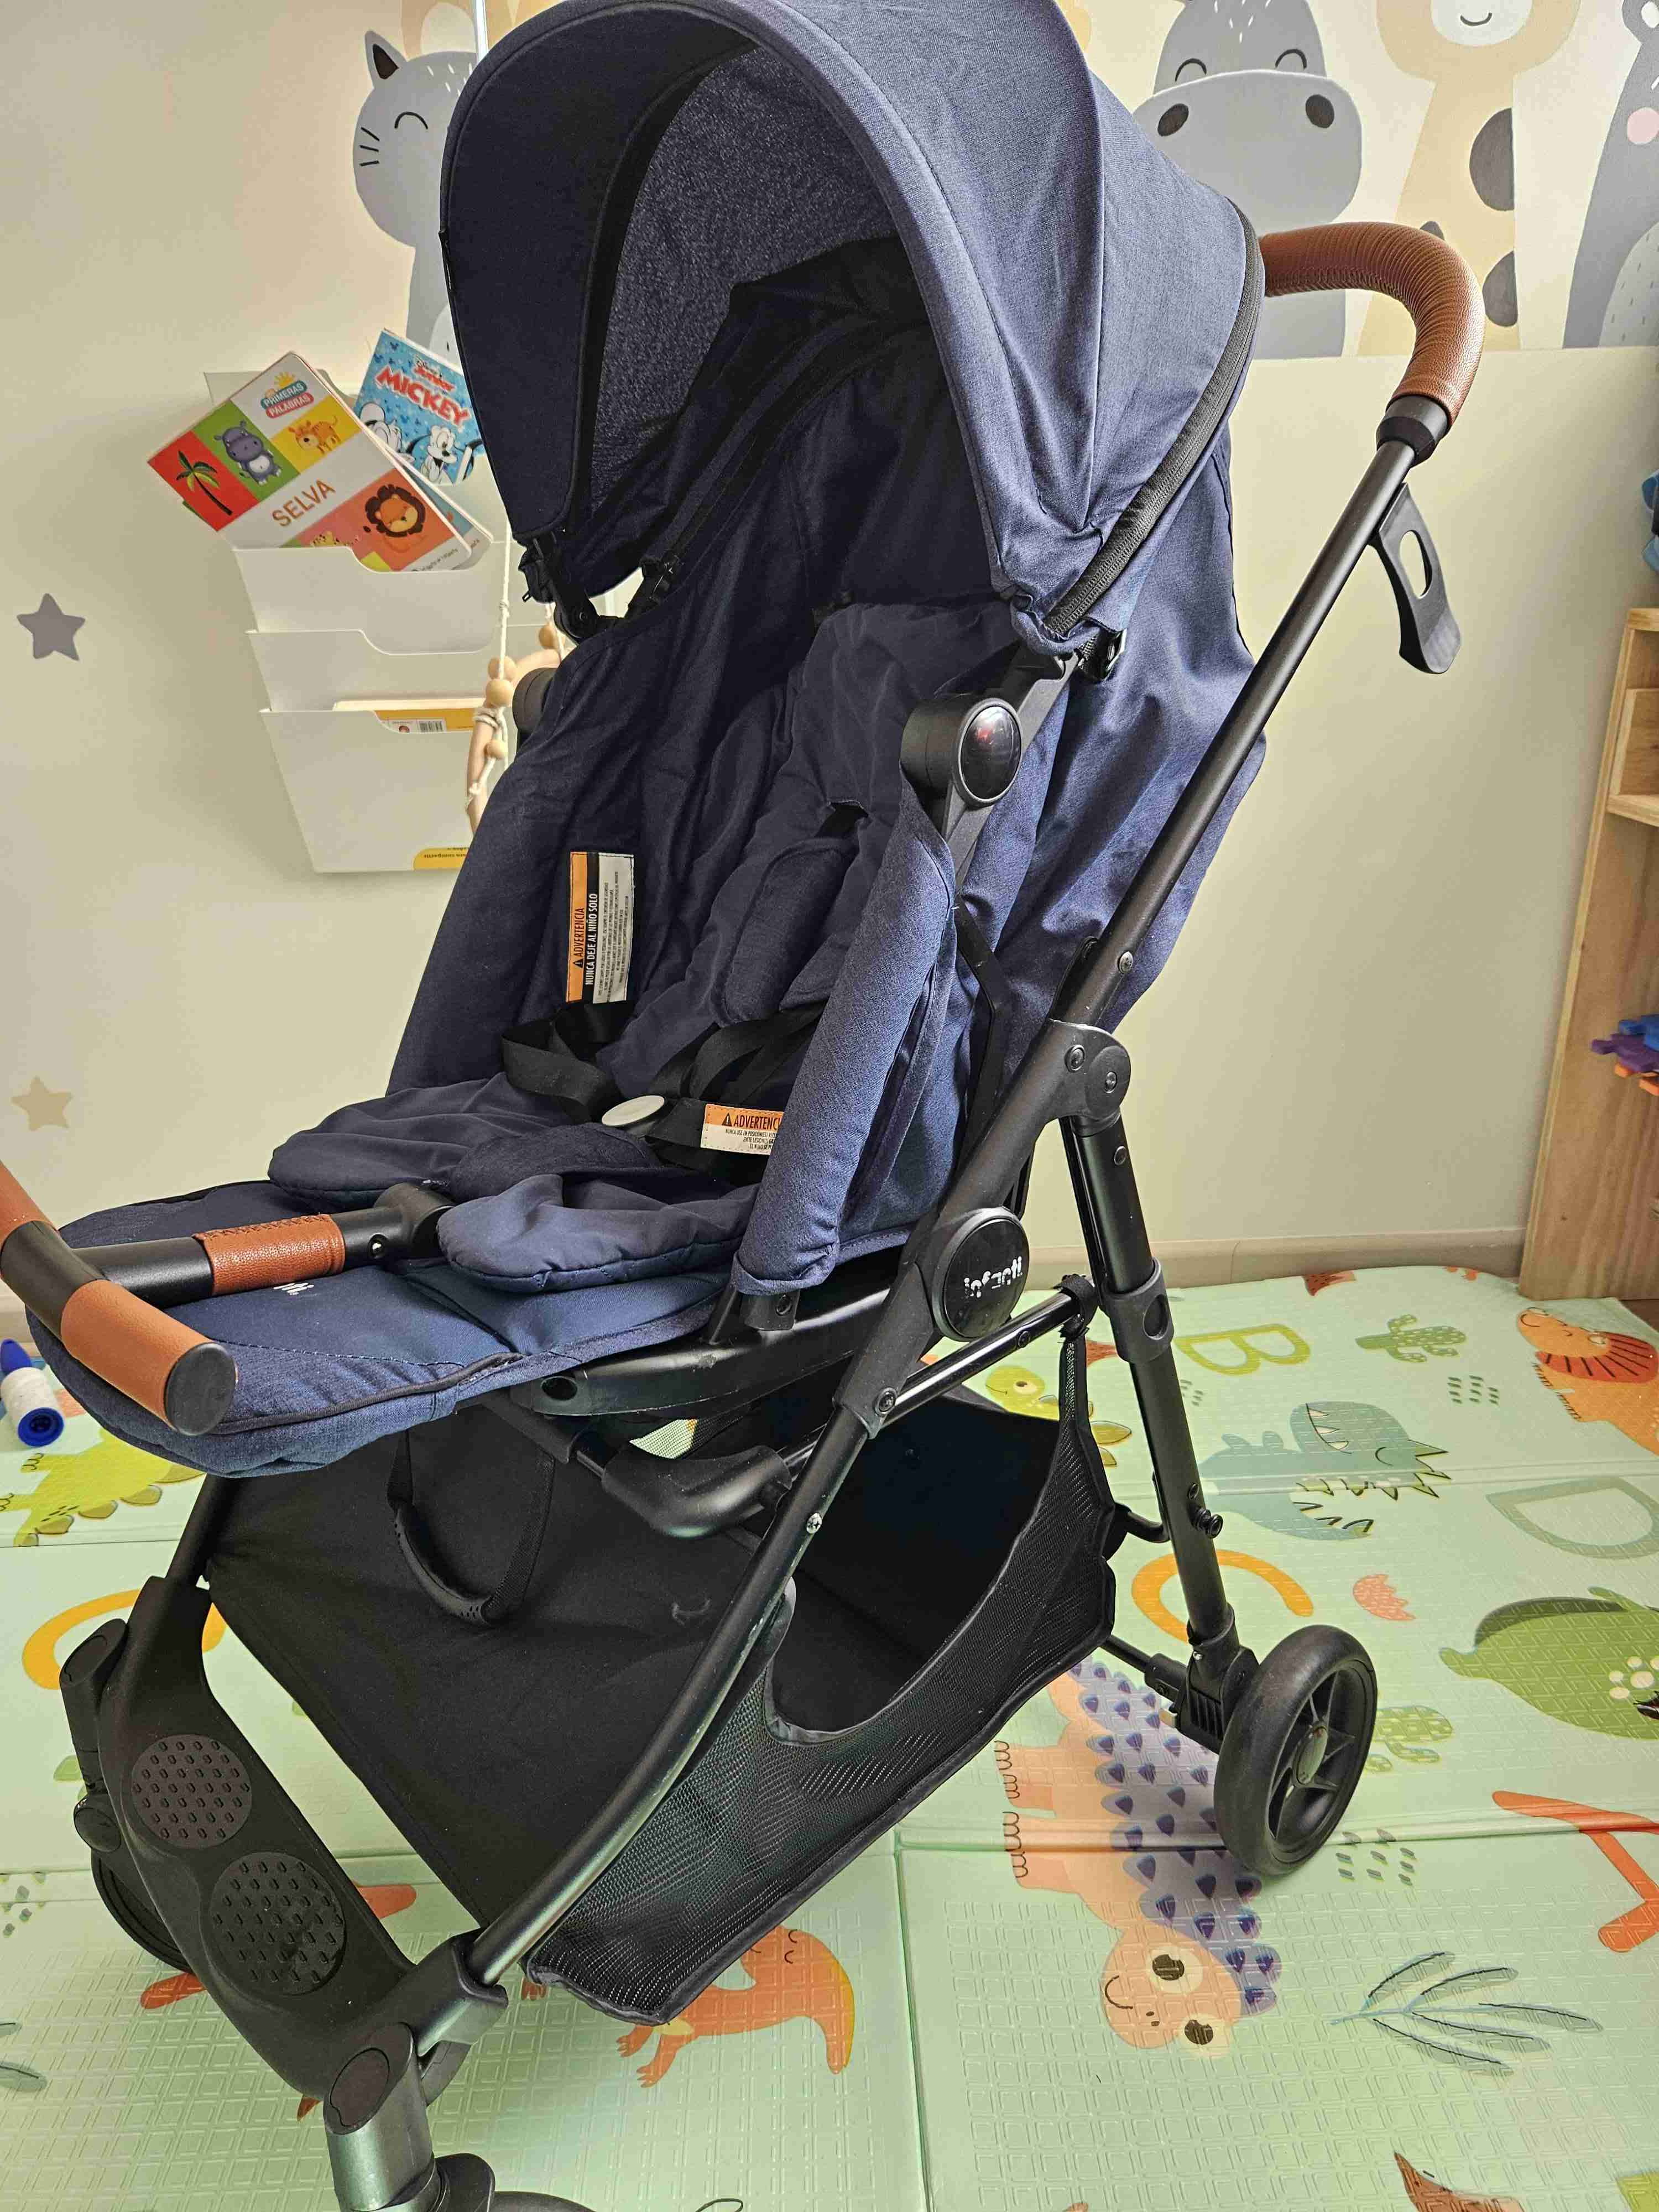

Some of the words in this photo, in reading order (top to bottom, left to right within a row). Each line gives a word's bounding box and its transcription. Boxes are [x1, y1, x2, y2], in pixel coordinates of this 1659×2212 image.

[263, 382, 304, 406] PRIMERAS
[268, 394, 311, 416] PALABRAS
[375, 365, 471, 428] MICKEY
[272, 480, 336, 526] SELVA
[588, 893, 598, 912] SOLO
[573, 907, 585, 958] ADVERTENCIA
[586, 914, 597, 932] NIÑO
[588, 933, 596, 942] AL
[587, 943, 596, 960] DEJE
[585, 961, 594, 985] NUNCA
[733, 1114, 781, 1131] ADVERTENCI
[1173, 1323, 1311, 1376] B
